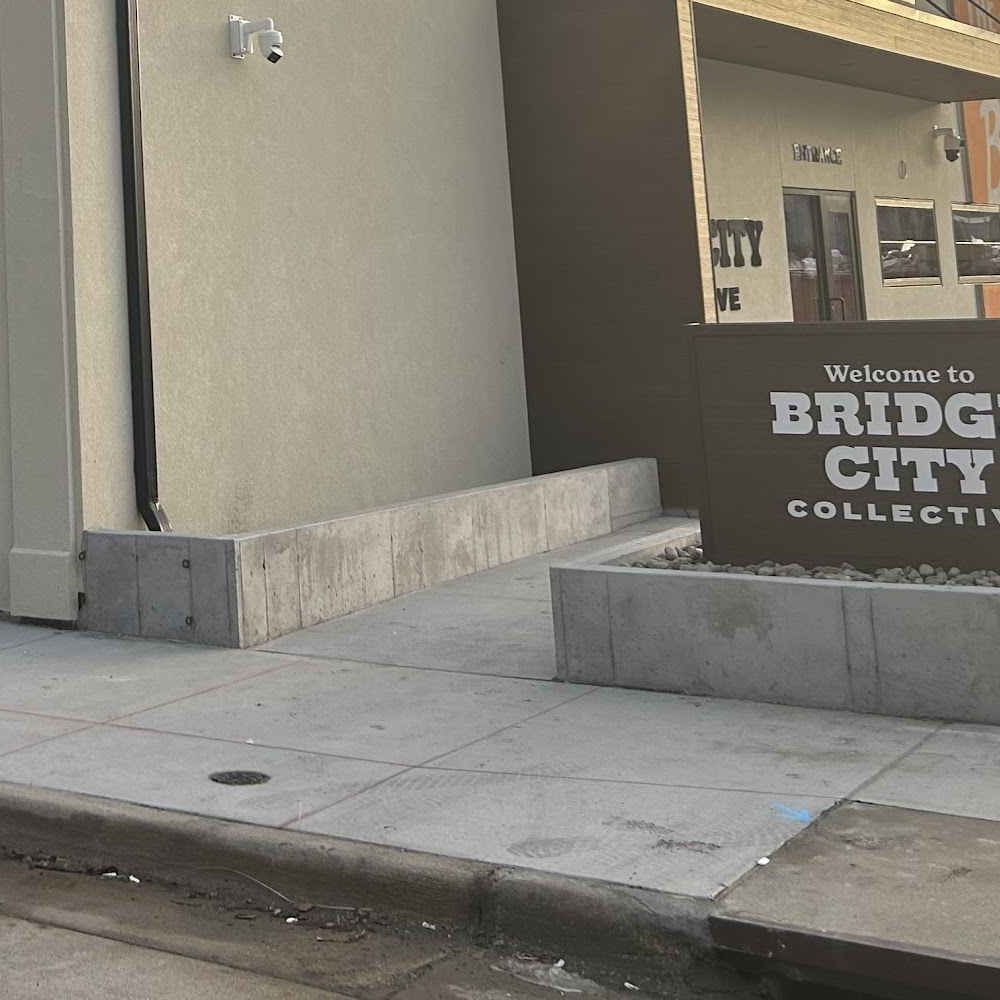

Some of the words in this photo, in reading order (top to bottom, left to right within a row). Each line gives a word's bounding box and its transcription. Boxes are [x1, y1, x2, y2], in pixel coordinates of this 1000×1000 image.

[823, 364, 941, 384] Welcome
[947, 365, 975, 384] to
[770, 391, 1000, 439] BRIDG
[825, 445, 995, 495] CITY
